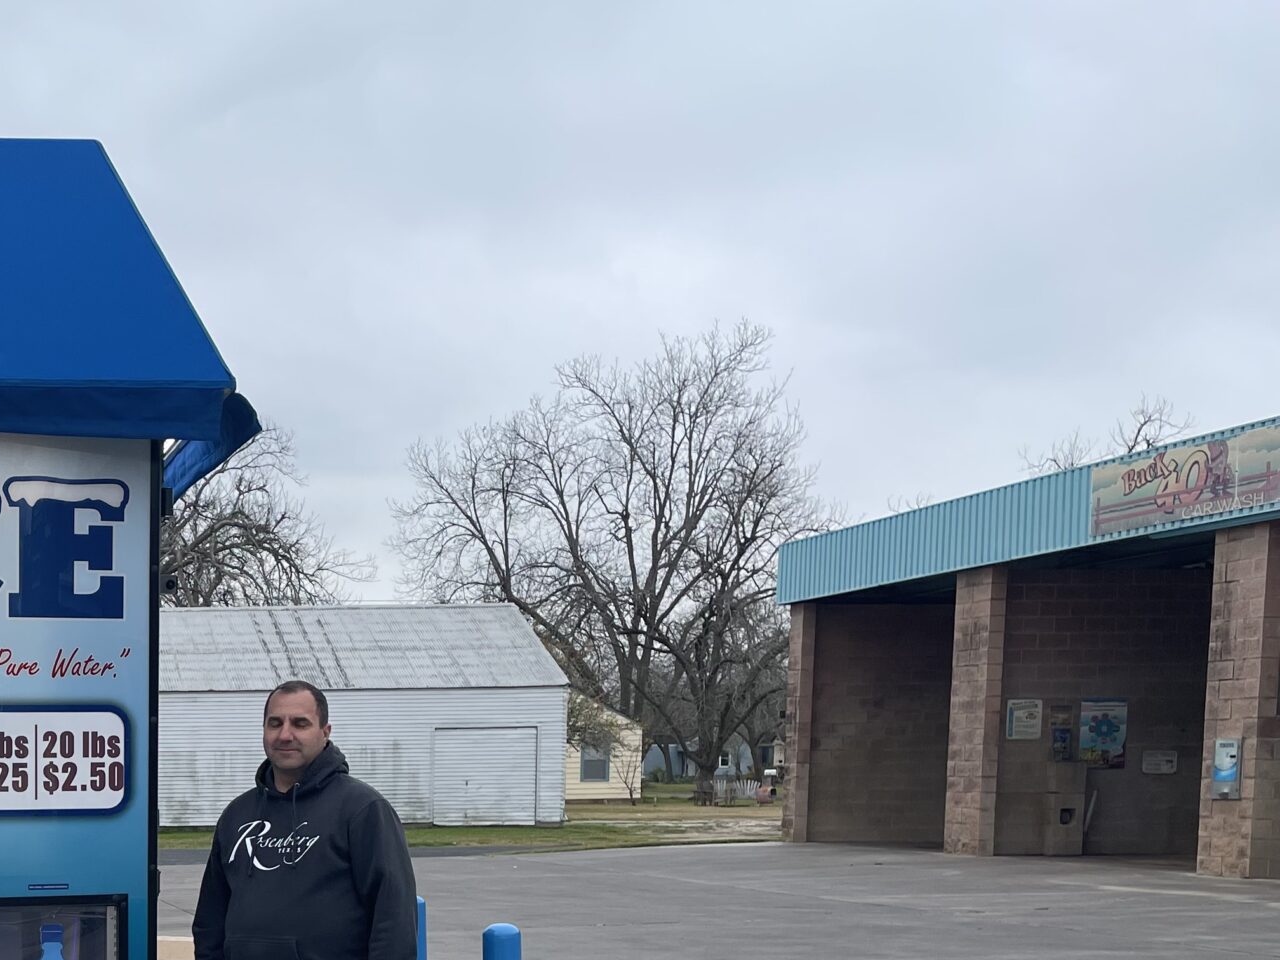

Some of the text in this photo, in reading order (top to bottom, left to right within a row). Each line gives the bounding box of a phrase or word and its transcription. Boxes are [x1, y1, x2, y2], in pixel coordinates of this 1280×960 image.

[1181, 491, 1264, 519] CAR WASH
[42, 730, 121, 758] 20 lbs
[42, 760, 124, 795] $2.50
